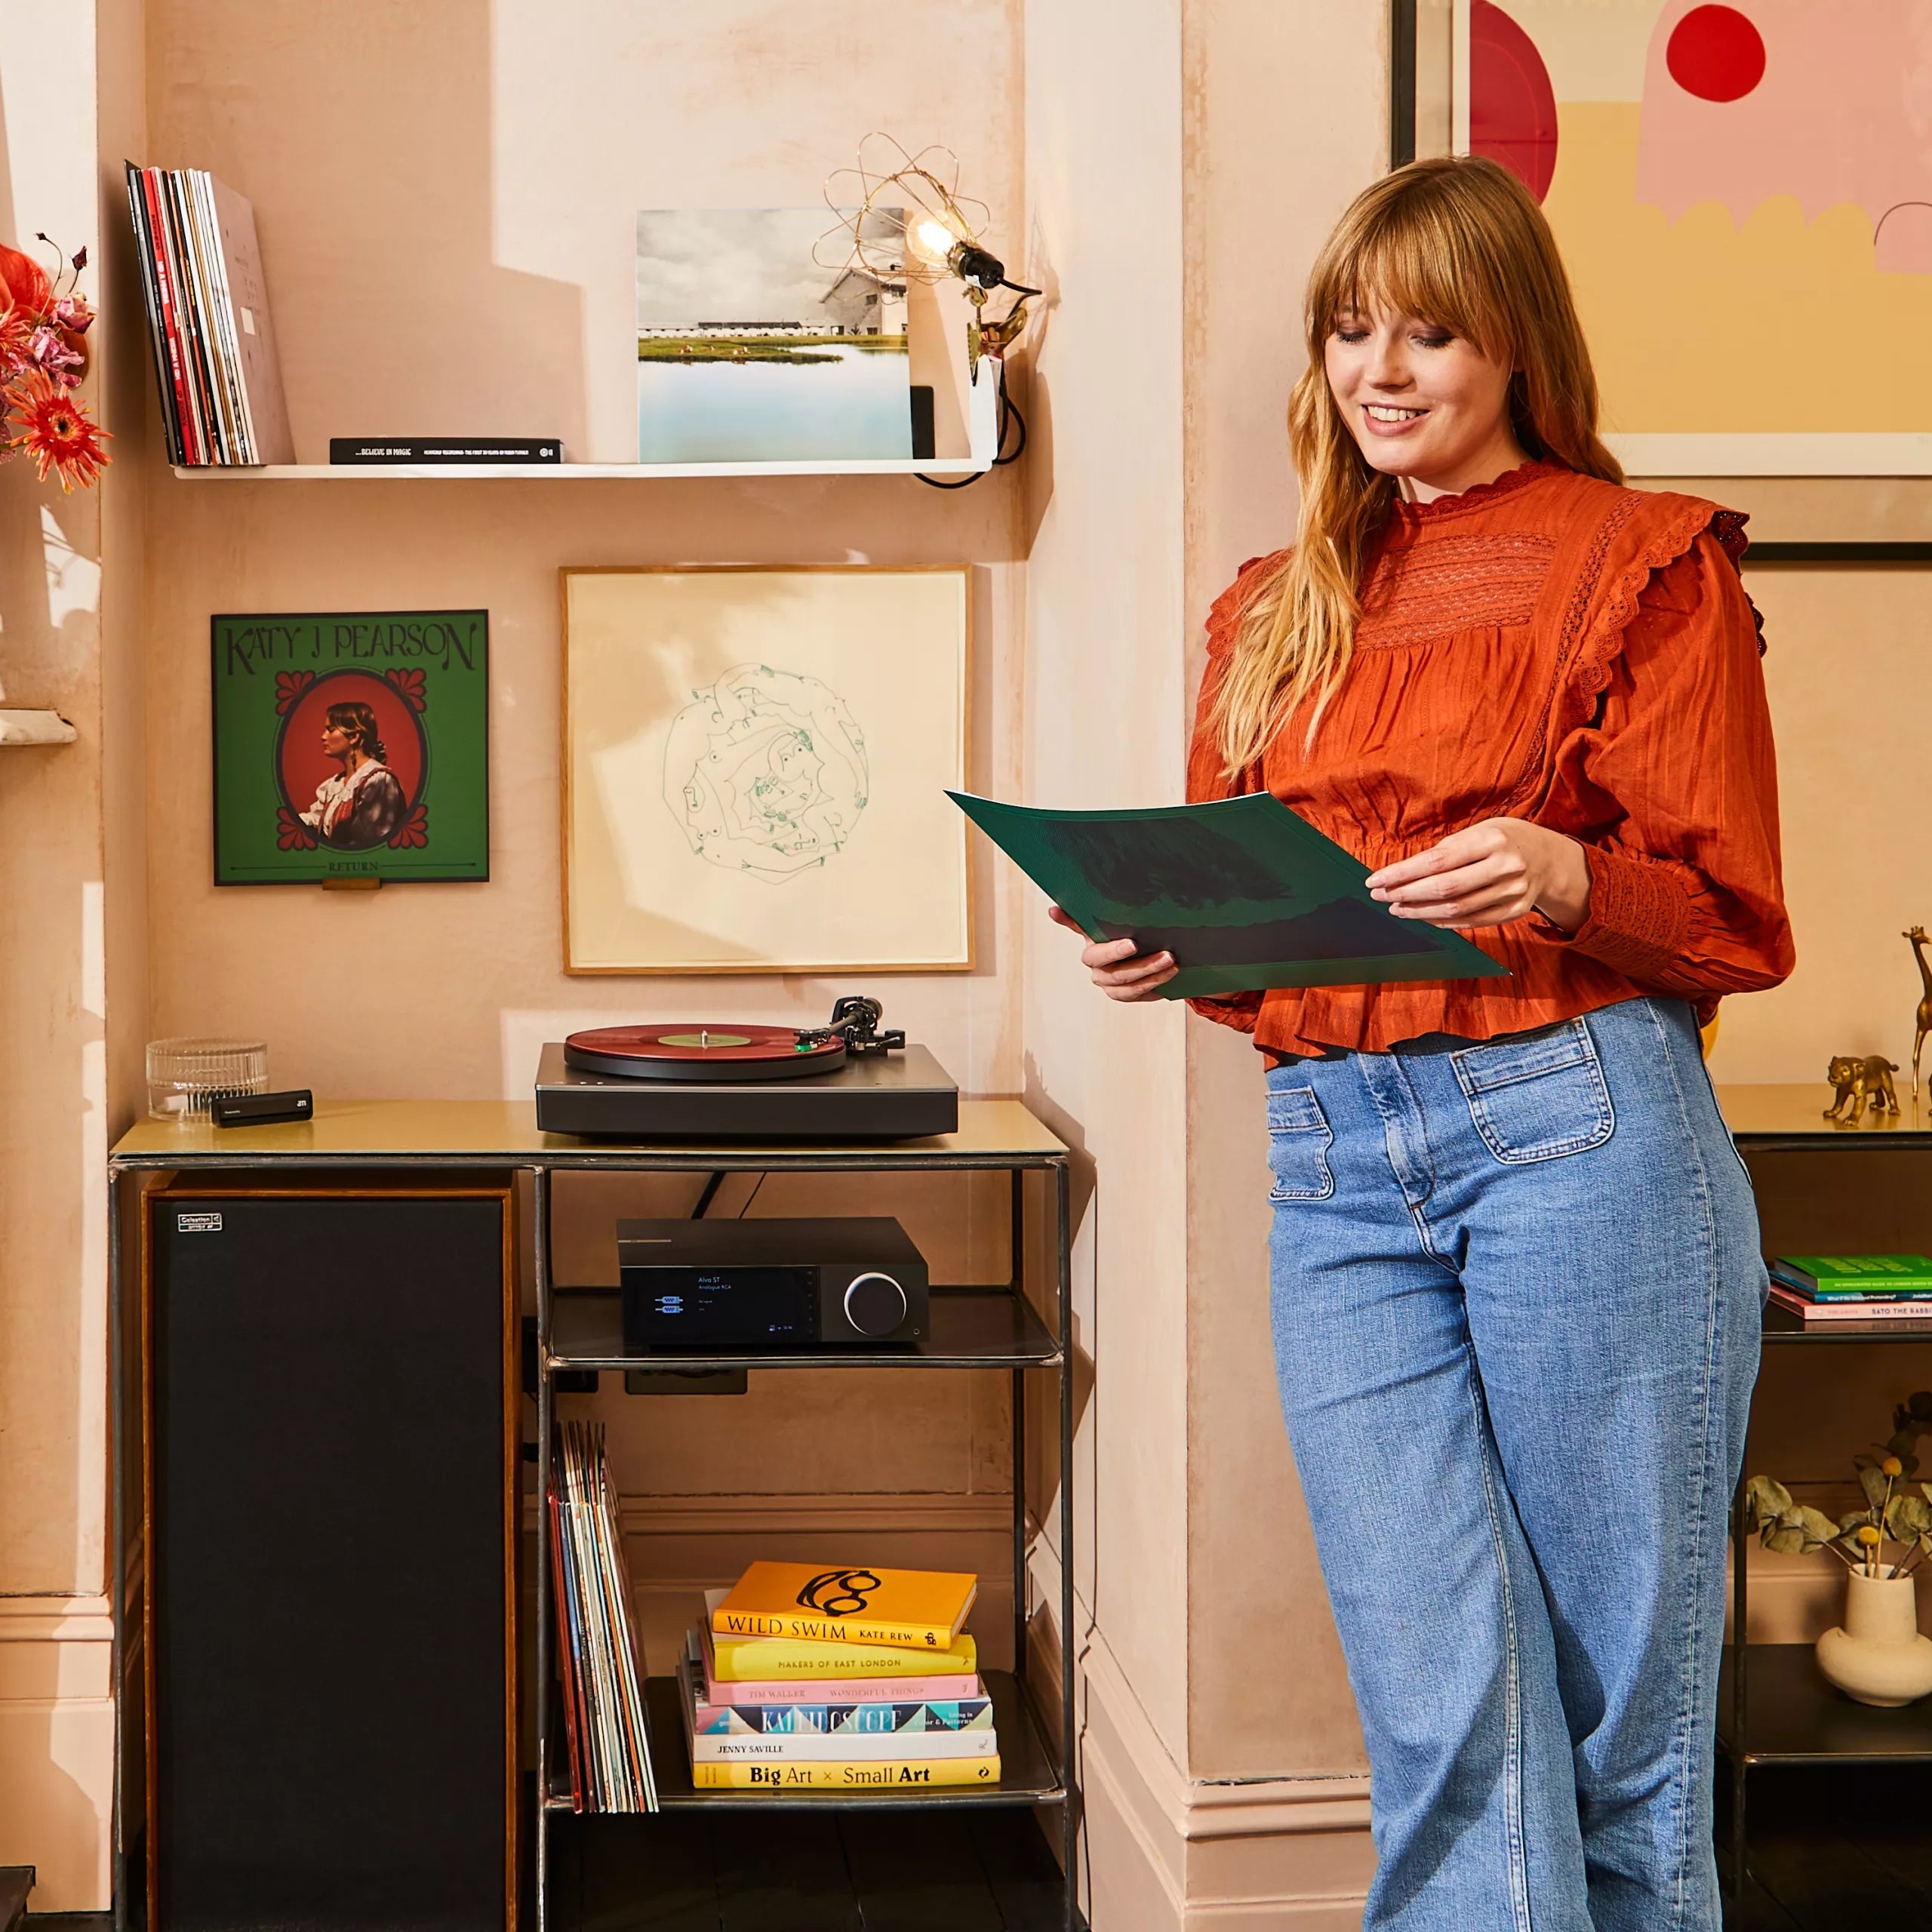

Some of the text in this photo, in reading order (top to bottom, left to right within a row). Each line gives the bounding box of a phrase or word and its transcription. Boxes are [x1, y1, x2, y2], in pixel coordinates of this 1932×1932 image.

[225, 623, 477, 676] KATY J PEARSON
[328, 861, 379, 872] RETURN
[727, 1616, 913, 1641] WILD SWIM KATE REW
[778, 1660, 814, 1669] MAKERS
[818, 1660, 830, 1669] OF
[860, 1659, 901, 1668] LONDON
[749, 1687, 924, 1699] TIM WALKER WONDERFUL THINGS
[718, 1745, 784, 1754] JENNY SAVILLE
[750, 1767, 781, 1785] Big
[786, 1767, 813, 1783] Art
[844, 1767, 893, 1783] Small
[899, 1767, 930, 1783] Art
